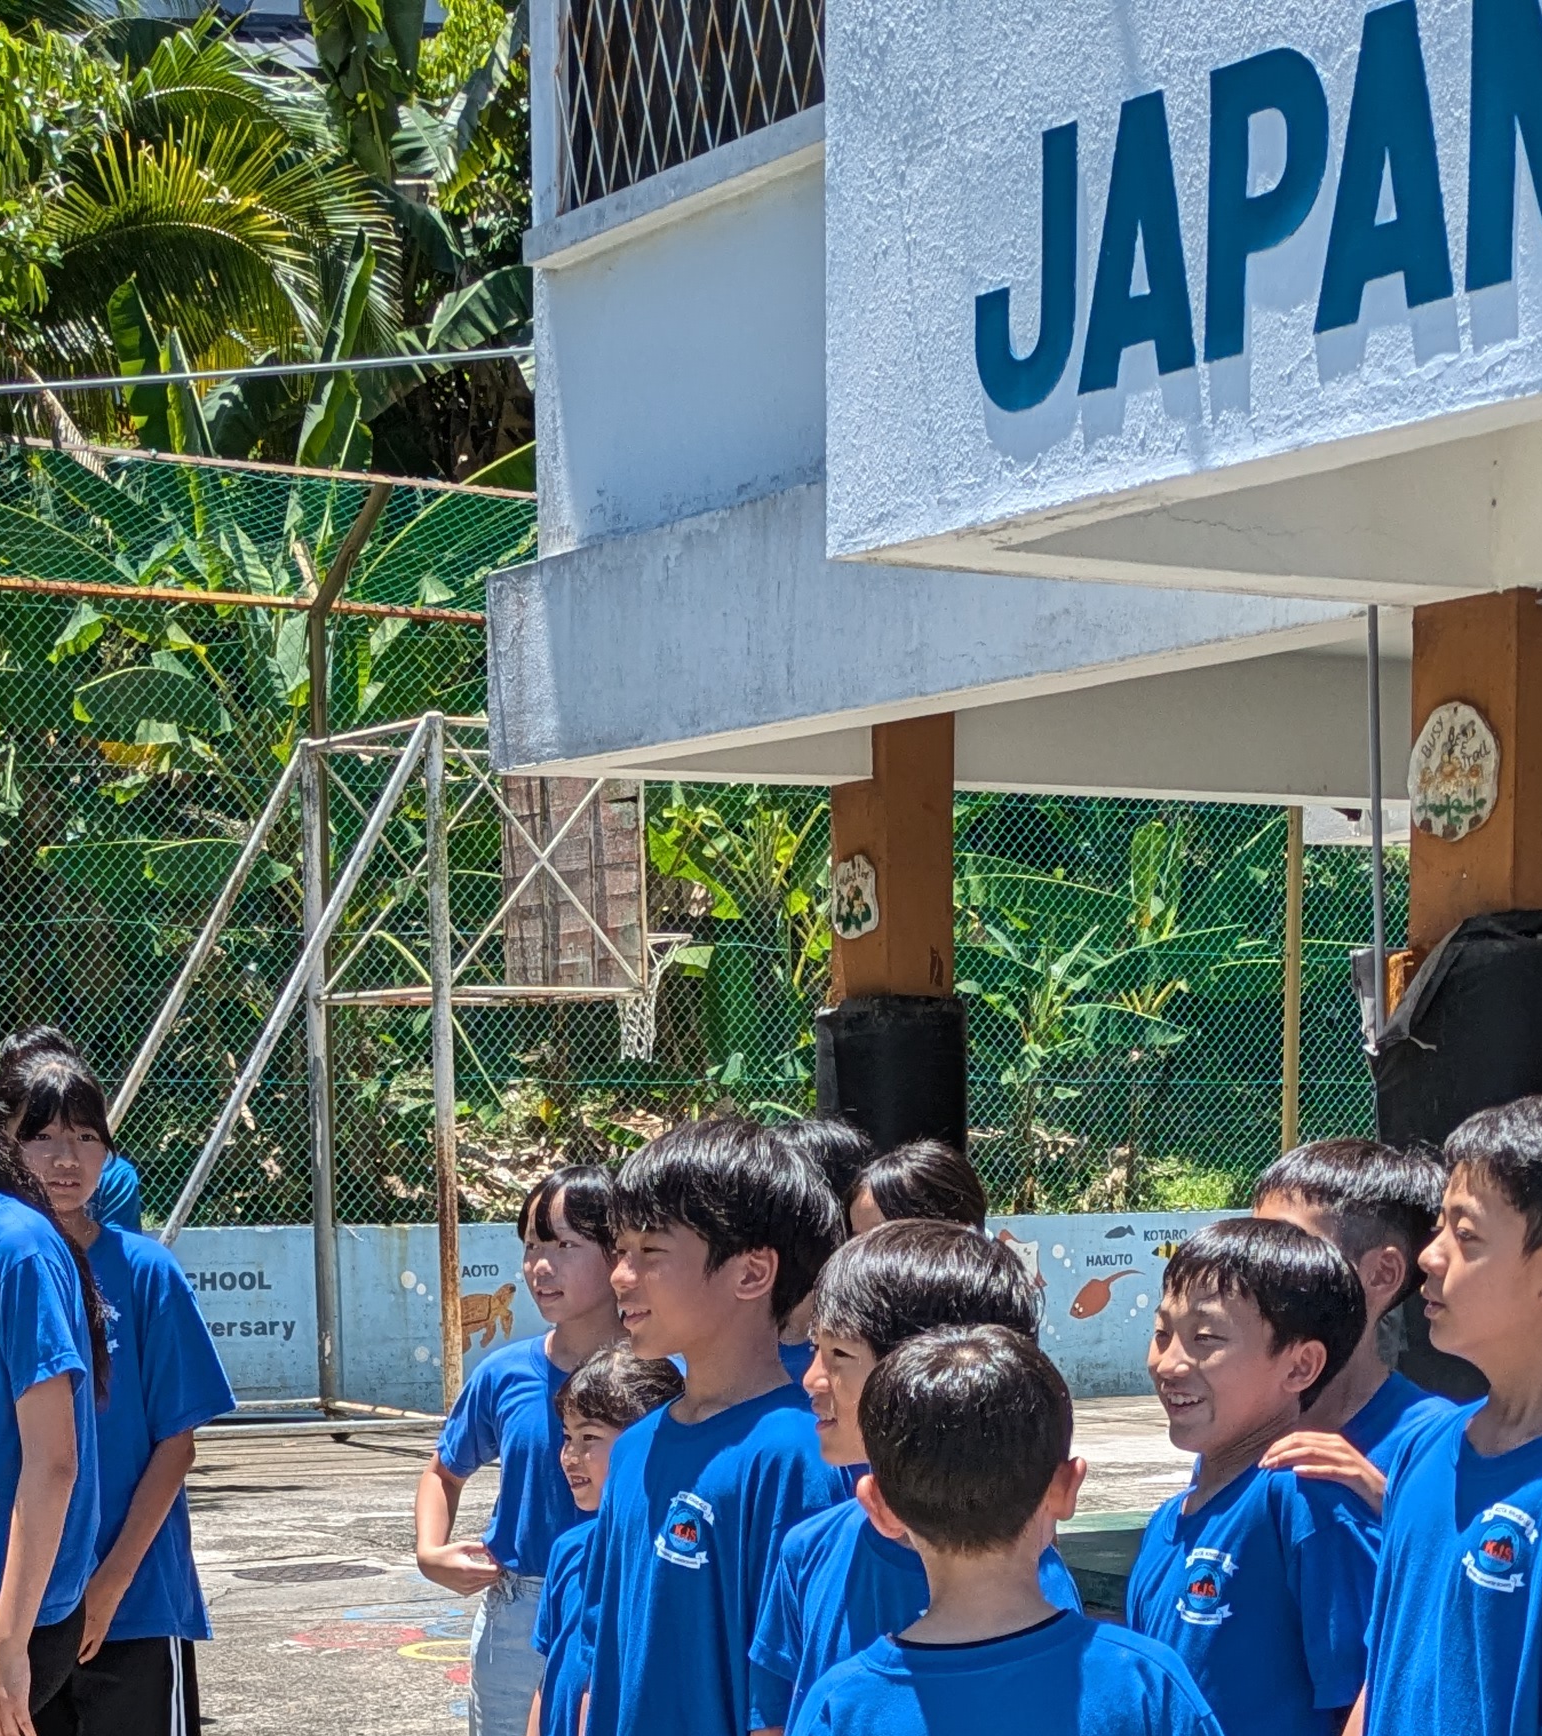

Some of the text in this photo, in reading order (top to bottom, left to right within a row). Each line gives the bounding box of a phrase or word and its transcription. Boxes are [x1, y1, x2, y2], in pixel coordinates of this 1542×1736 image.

[1421, 716, 1444, 759] BUSY
[1086, 1253, 1133, 1267] HAKUTO
[461, 1264, 499, 1278] AOTO
[207, 1320, 296, 1341] ersary
